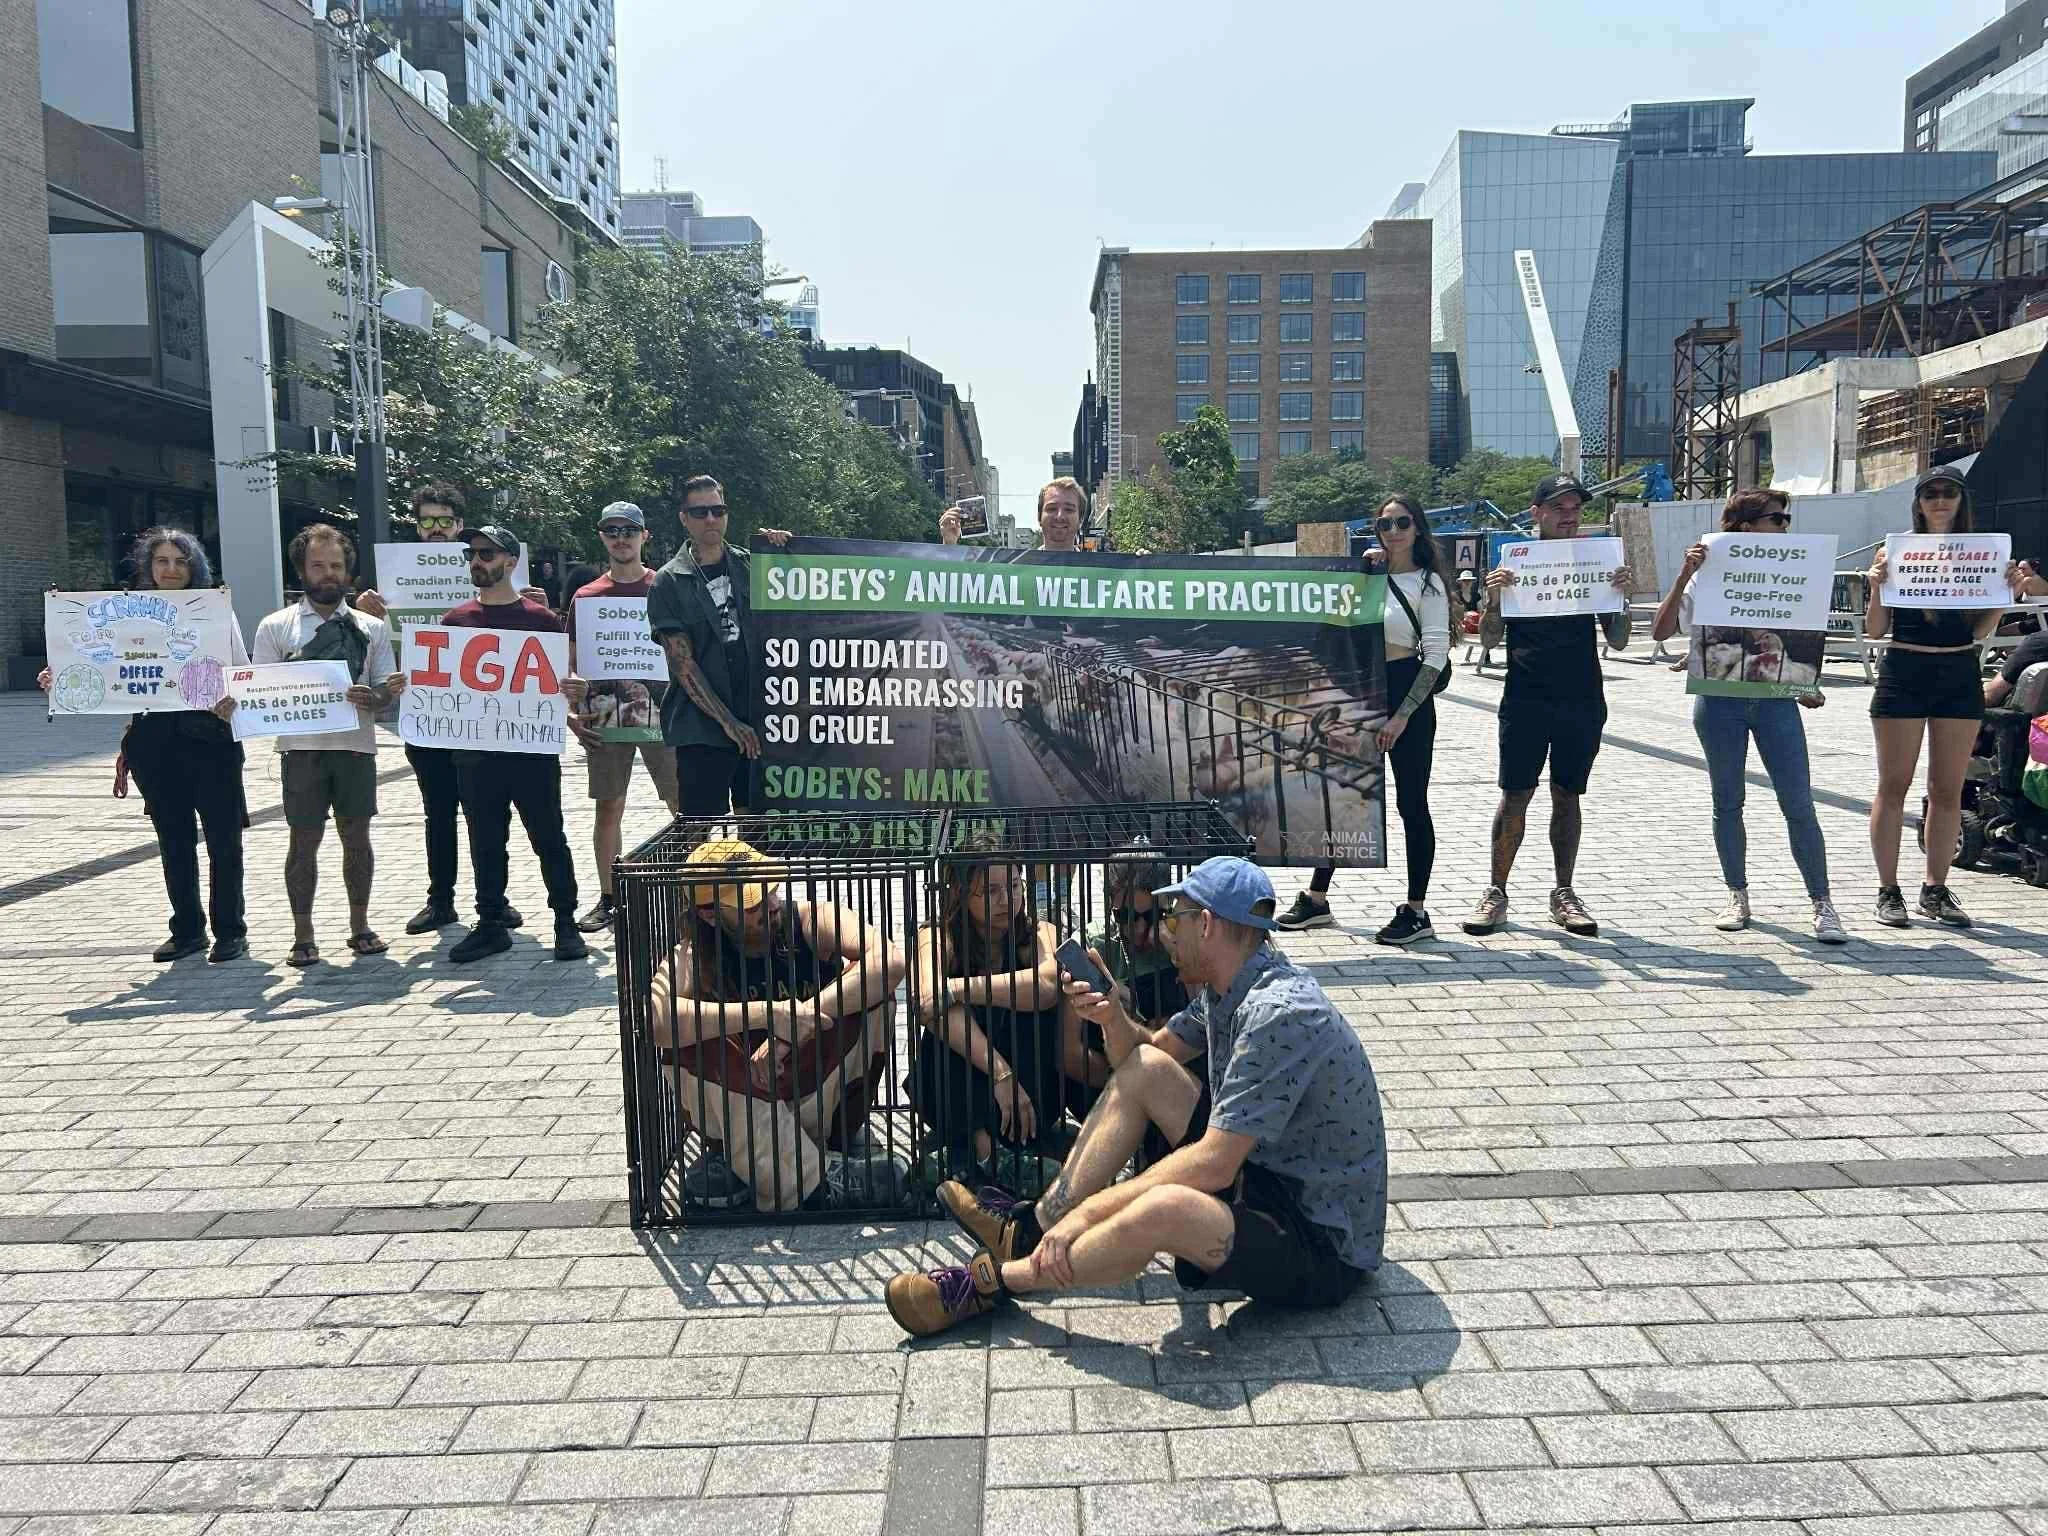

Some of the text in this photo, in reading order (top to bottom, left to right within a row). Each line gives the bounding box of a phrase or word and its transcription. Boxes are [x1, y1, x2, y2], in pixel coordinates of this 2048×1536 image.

[1459, 545, 1472, 562] A
[1509, 547, 1529, 557] IGA
[1729, 544, 1807, 561] Sobeys:
[1903, 552, 1935, 561] OSEZ
[1938, 552, 1953, 561] LA
[1957, 552, 1989, 561] CAGE
[1898, 564, 1997, 574] RESTEZ 5 minutes
[396, 576, 451, 587] Canadian
[1513, 571, 1614, 587] PAS de POULES
[1723, 572, 1807, 586] Fulfill Your
[1911, 575, 1982, 584] dans la CAGE
[413, 591, 444, 600] want
[447, 592, 470, 602] you
[904, 570, 1025, 606] ANIMAL
[1036, 575, 1174, 609] WELFARE
[1184, 580, 1362, 617] PRACTICES:
[1536, 588, 1590, 601] en CAGE
[1723, 589, 1803, 602] Cage-Free
[1899, 588, 1948, 597] RECEVEZ
[1951, 588, 1964, 597] 20
[1730, 606, 1793, 619] Promise
[595, 632, 650, 641] Fulfill Yo
[597, 646, 661, 657] Cage-Free
[765, 639, 948, 669] SO OUTDATED
[410, 630, 560, 694] IGA
[603, 661, 655, 671] Promise
[119, 665, 164, 679] DIFFER
[232, 671, 254, 682] IGA
[127, 681, 160, 695] ENT
[764, 676, 1023, 709] SO EMBARRASSING
[240, 692, 344, 711] PAS de POULES
[411, 688, 472, 713] STOP
[517, 699, 555, 721] LA
[263, 708, 327, 723] en CAGES
[495, 718, 567, 744] ANIMALE
[765, 715, 894, 745] SO CRUEL
[765, 765, 990, 802] SOBEYS: MAKE
[1321, 831, 1377, 844] ANIMAL
[1321, 846, 1378, 859] JUSTICE
